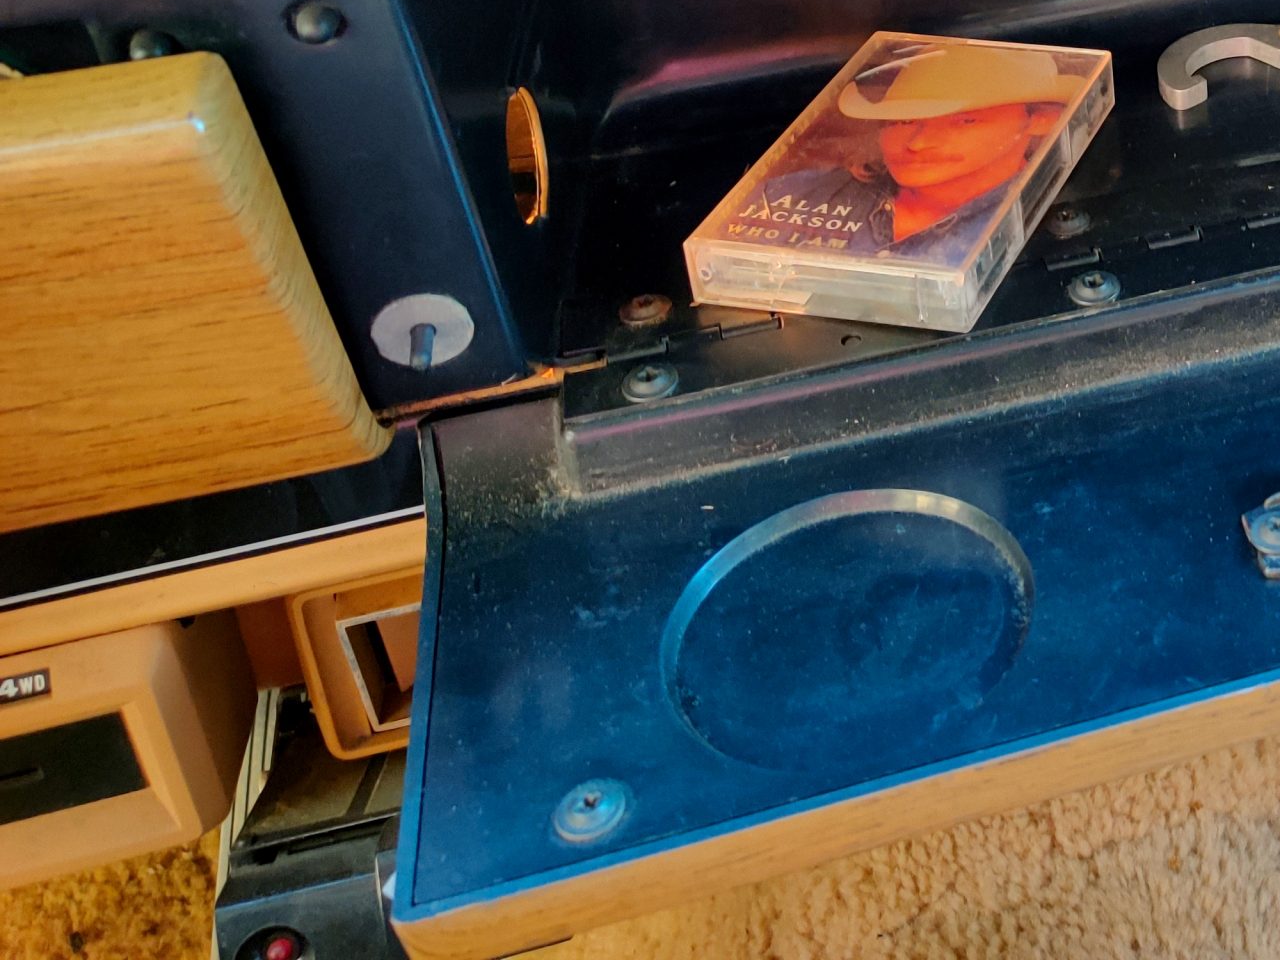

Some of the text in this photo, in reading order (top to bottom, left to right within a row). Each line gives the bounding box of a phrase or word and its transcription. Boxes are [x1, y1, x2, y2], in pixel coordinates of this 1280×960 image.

[770, 194, 852, 217] ALAN
[738, 204, 863, 233] JACKSON
[727, 223, 850, 249] WHO I AM
[0, 673, 46, 698] 4WD
